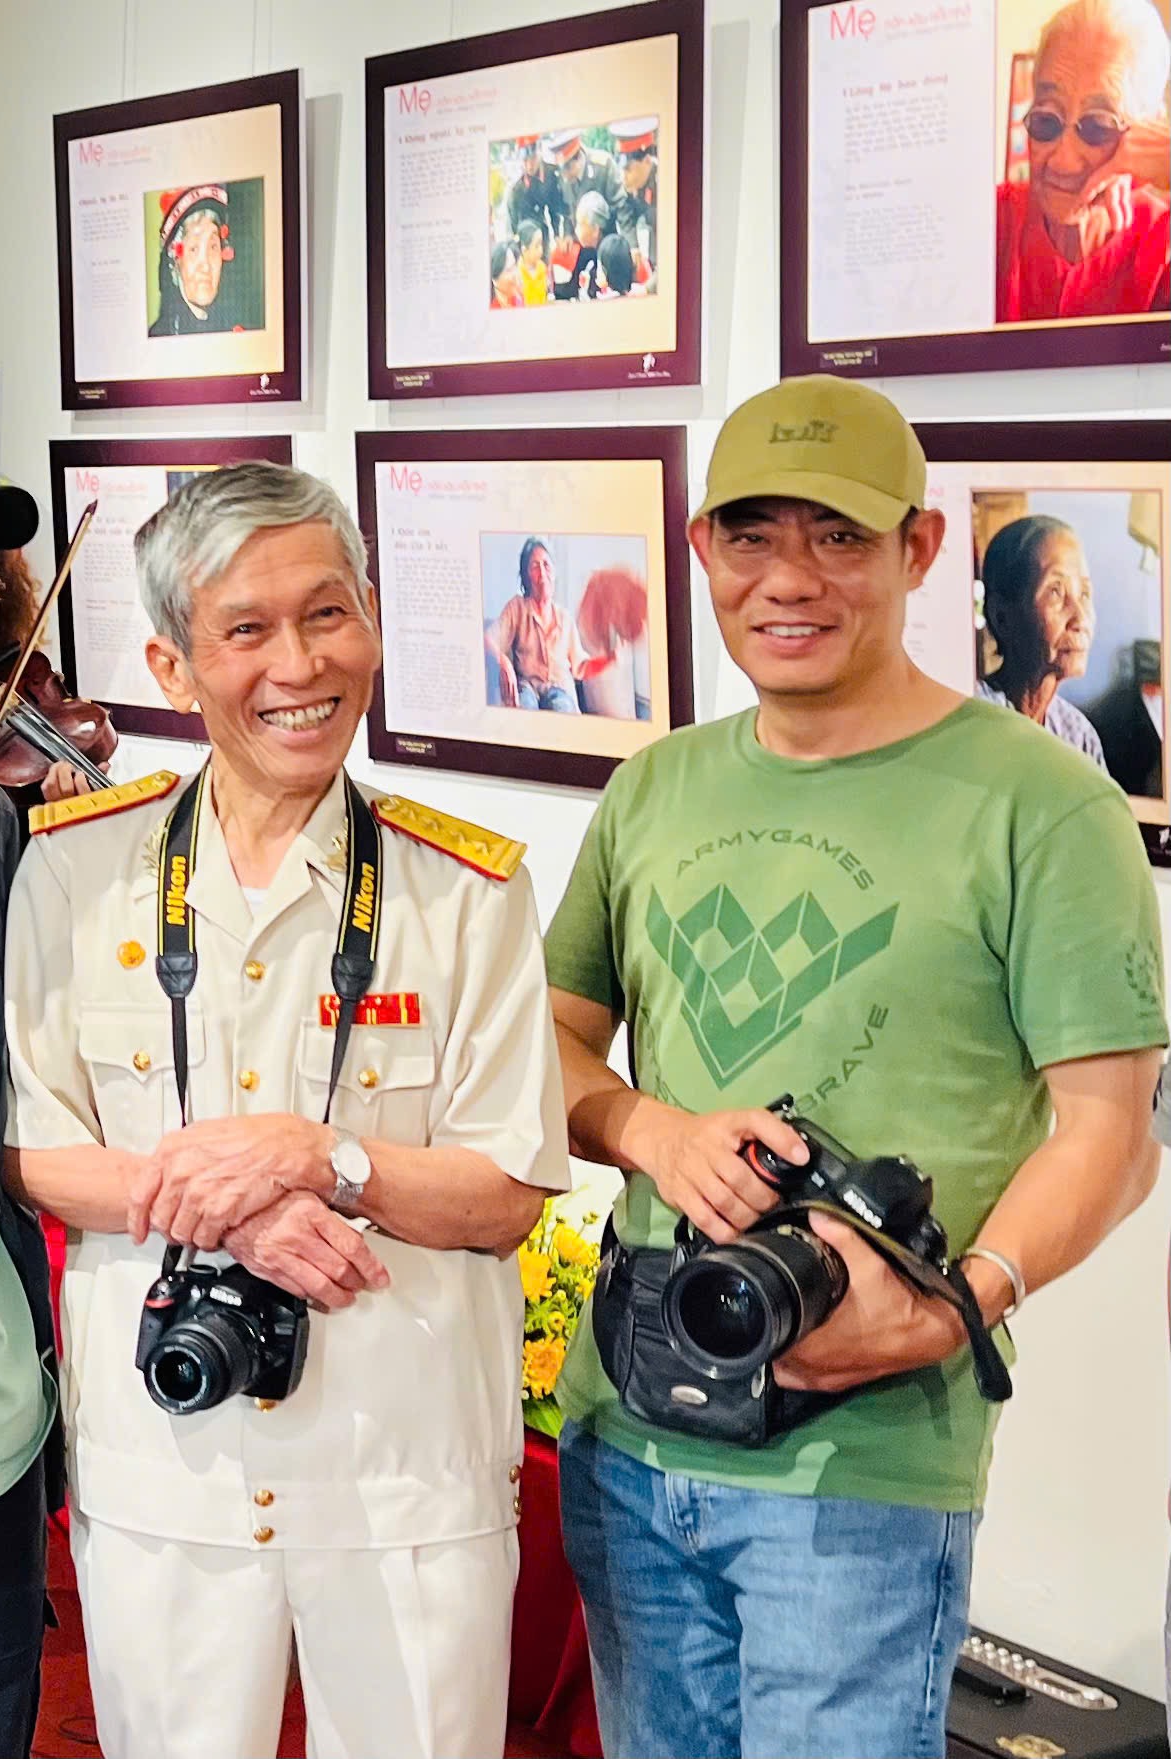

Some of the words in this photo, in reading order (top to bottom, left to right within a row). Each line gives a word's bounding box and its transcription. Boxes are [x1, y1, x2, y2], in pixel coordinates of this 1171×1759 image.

[831, 5, 876, 42] Mẹ
[399, 85, 432, 117] Mẹ
[166, 855, 187, 926] Nikon
[677, 828, 875, 891] ARMYGAMES
[351, 862, 375, 933] Nikon
